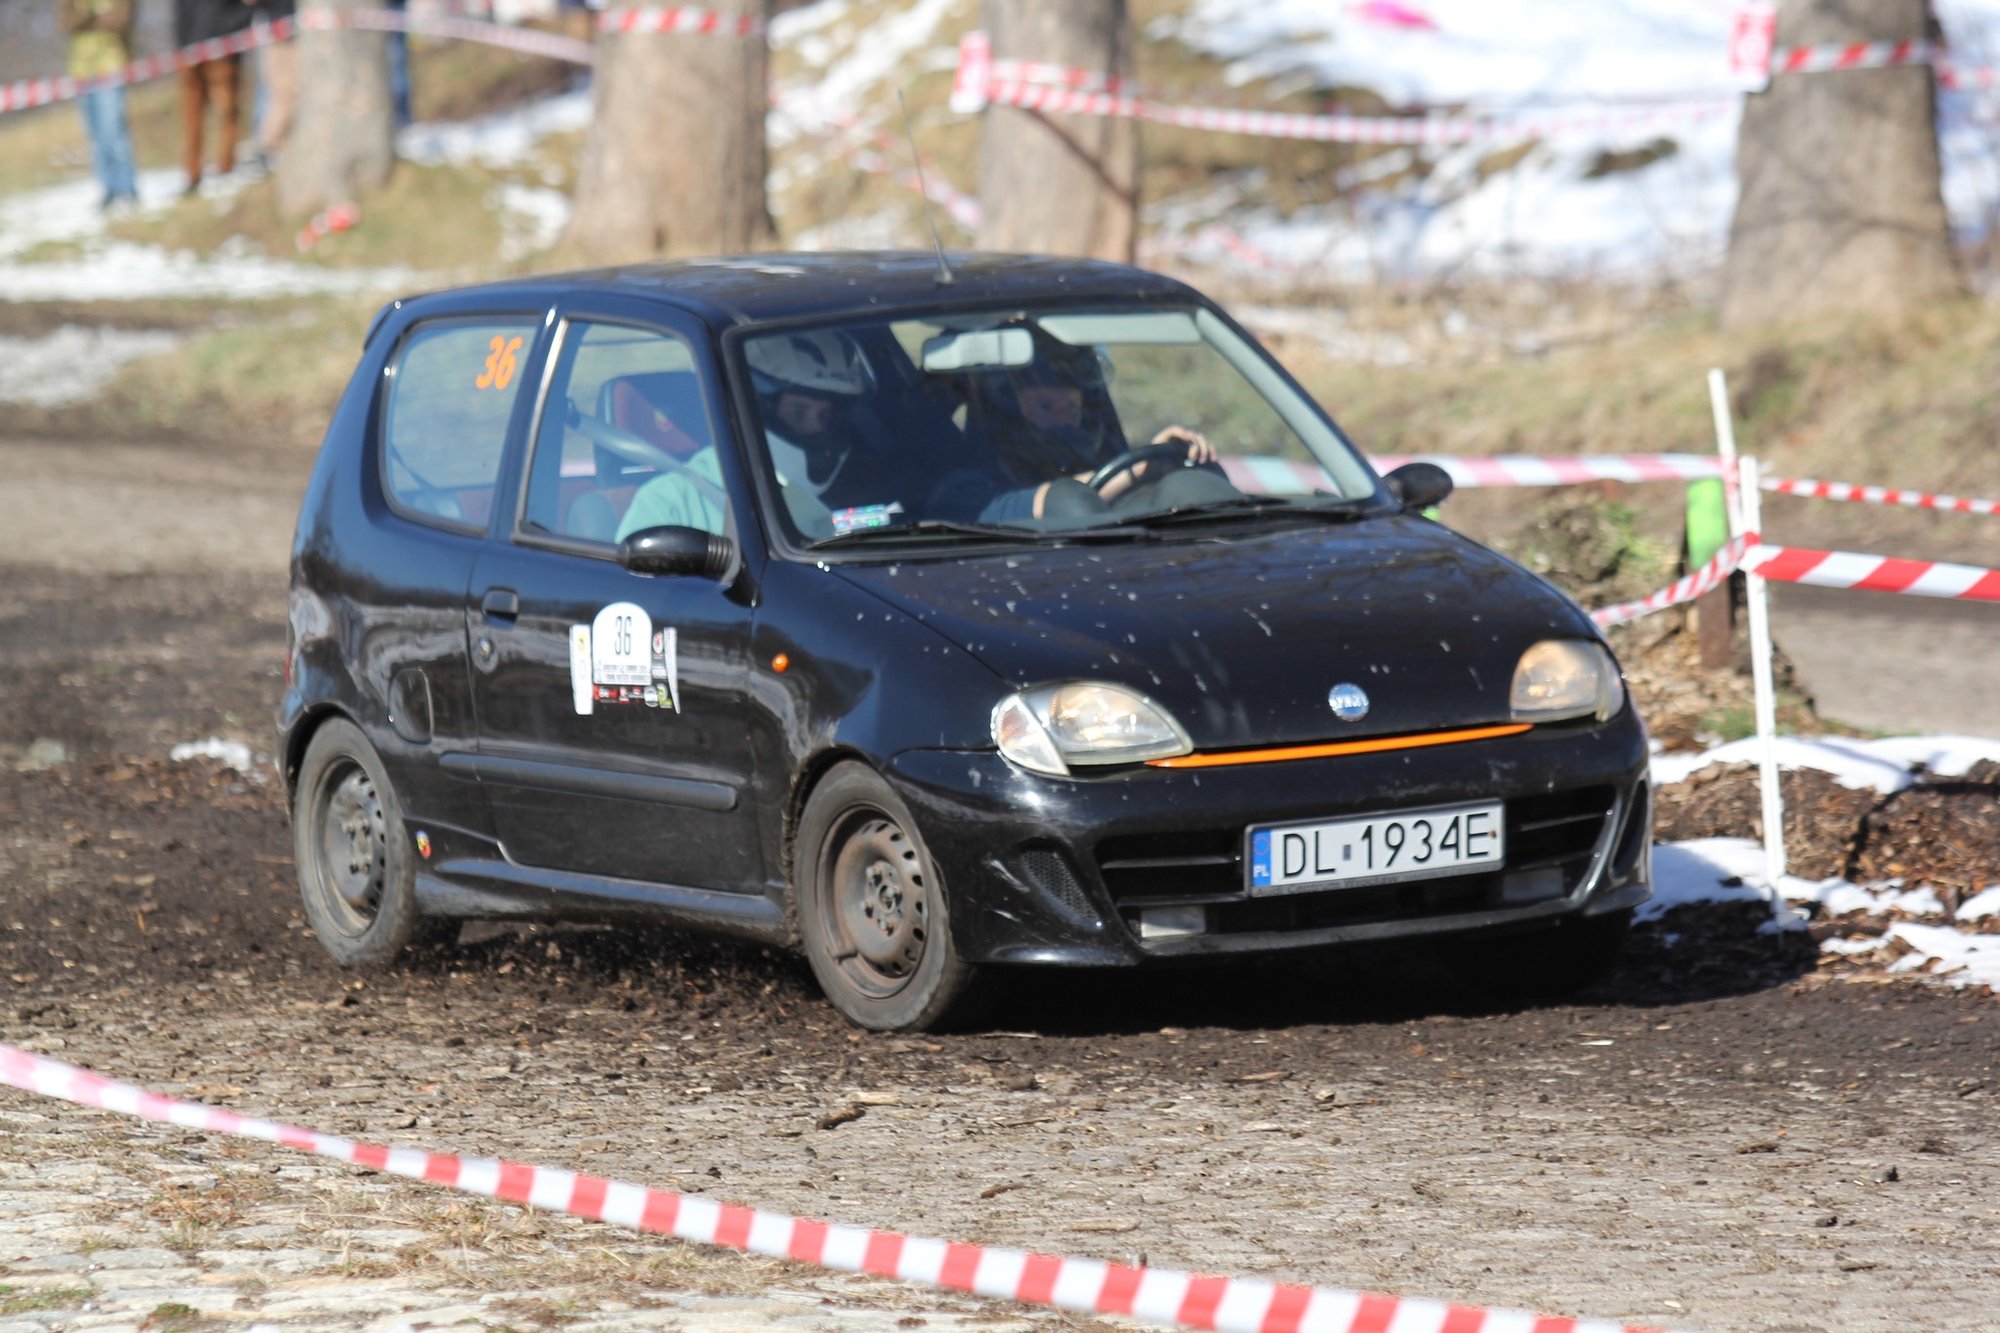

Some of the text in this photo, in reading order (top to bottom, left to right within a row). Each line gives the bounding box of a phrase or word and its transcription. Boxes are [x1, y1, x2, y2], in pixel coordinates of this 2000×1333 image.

[475, 335, 523, 390] 36
[614, 616, 632, 655] 36
[1283, 812, 1489, 878] DL 1934E
[1253, 866, 1269, 878] PL
